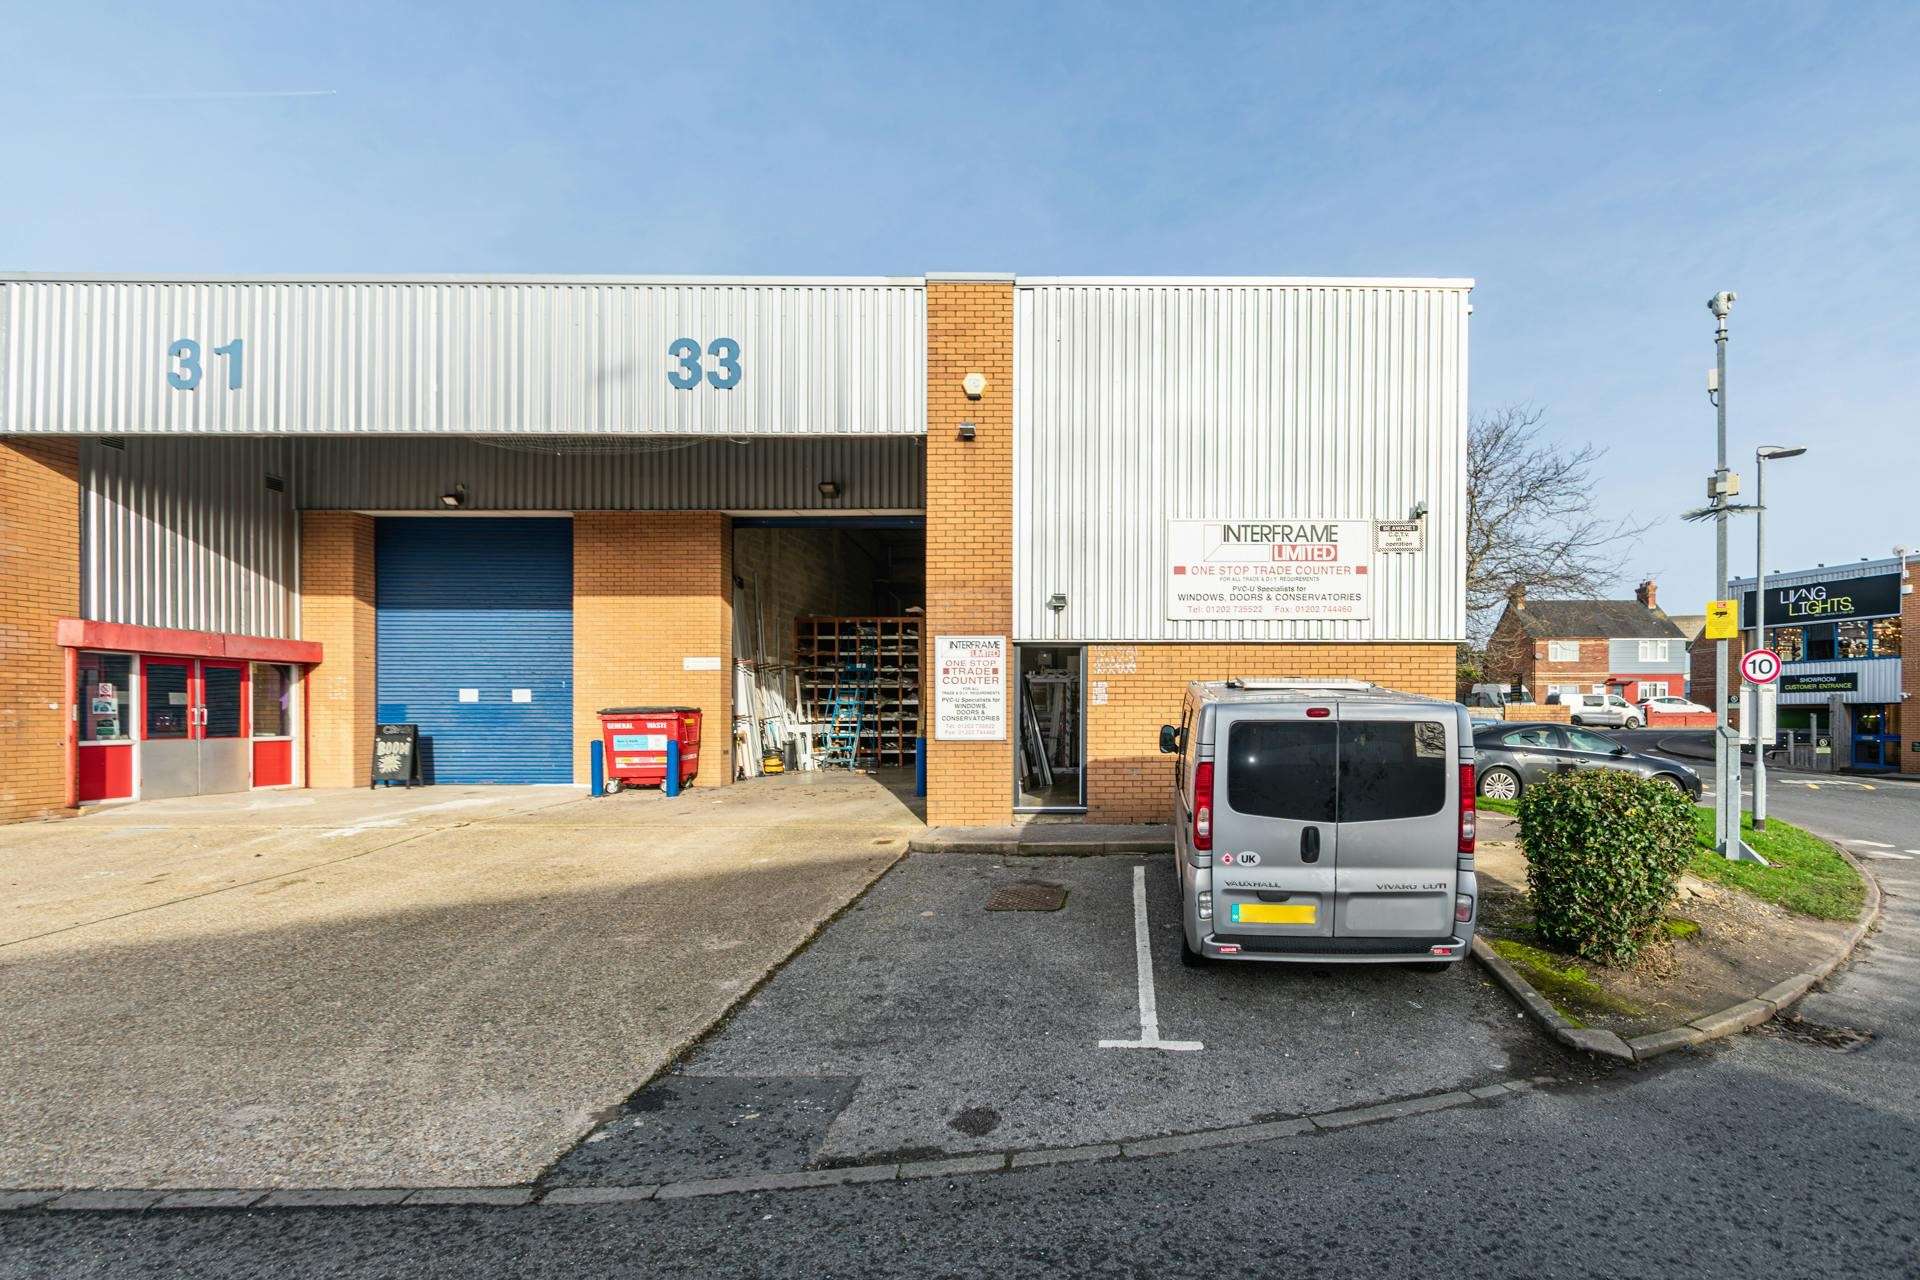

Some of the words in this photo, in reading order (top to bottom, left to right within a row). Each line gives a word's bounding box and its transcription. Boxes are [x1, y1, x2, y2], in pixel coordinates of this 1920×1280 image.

[167, 338, 242, 391] 31
[667, 338, 742, 390] 33
[1223, 524, 1338, 542] INTERFRAME
[1273, 545, 1336, 561] LIMITED
[1191, 565, 1215, 575] ONE
[1218, 565, 1250, 575] STOP
[1253, 565, 1293, 575] TRADE
[1295, 565, 1351, 575] COUNTER
[1257, 585, 1295, 593] Specialists
[1229, 593, 1263, 601] DOORS
[1266, 593, 1272, 601] &
[1275, 593, 1361, 601] CONSERVATORIES
[1295, 605, 1320, 613] 01202
[949, 640, 1001, 649] INTERFRAME
[952, 667, 991, 675] TRADE
[1749, 659, 1773, 674] 10
[942, 676, 999, 684] COUNTER
[1241, 854, 1256, 864] UK
[1224, 880, 1281, 888] VAUXHALL
[1376, 882, 1418, 890] VIVARO
